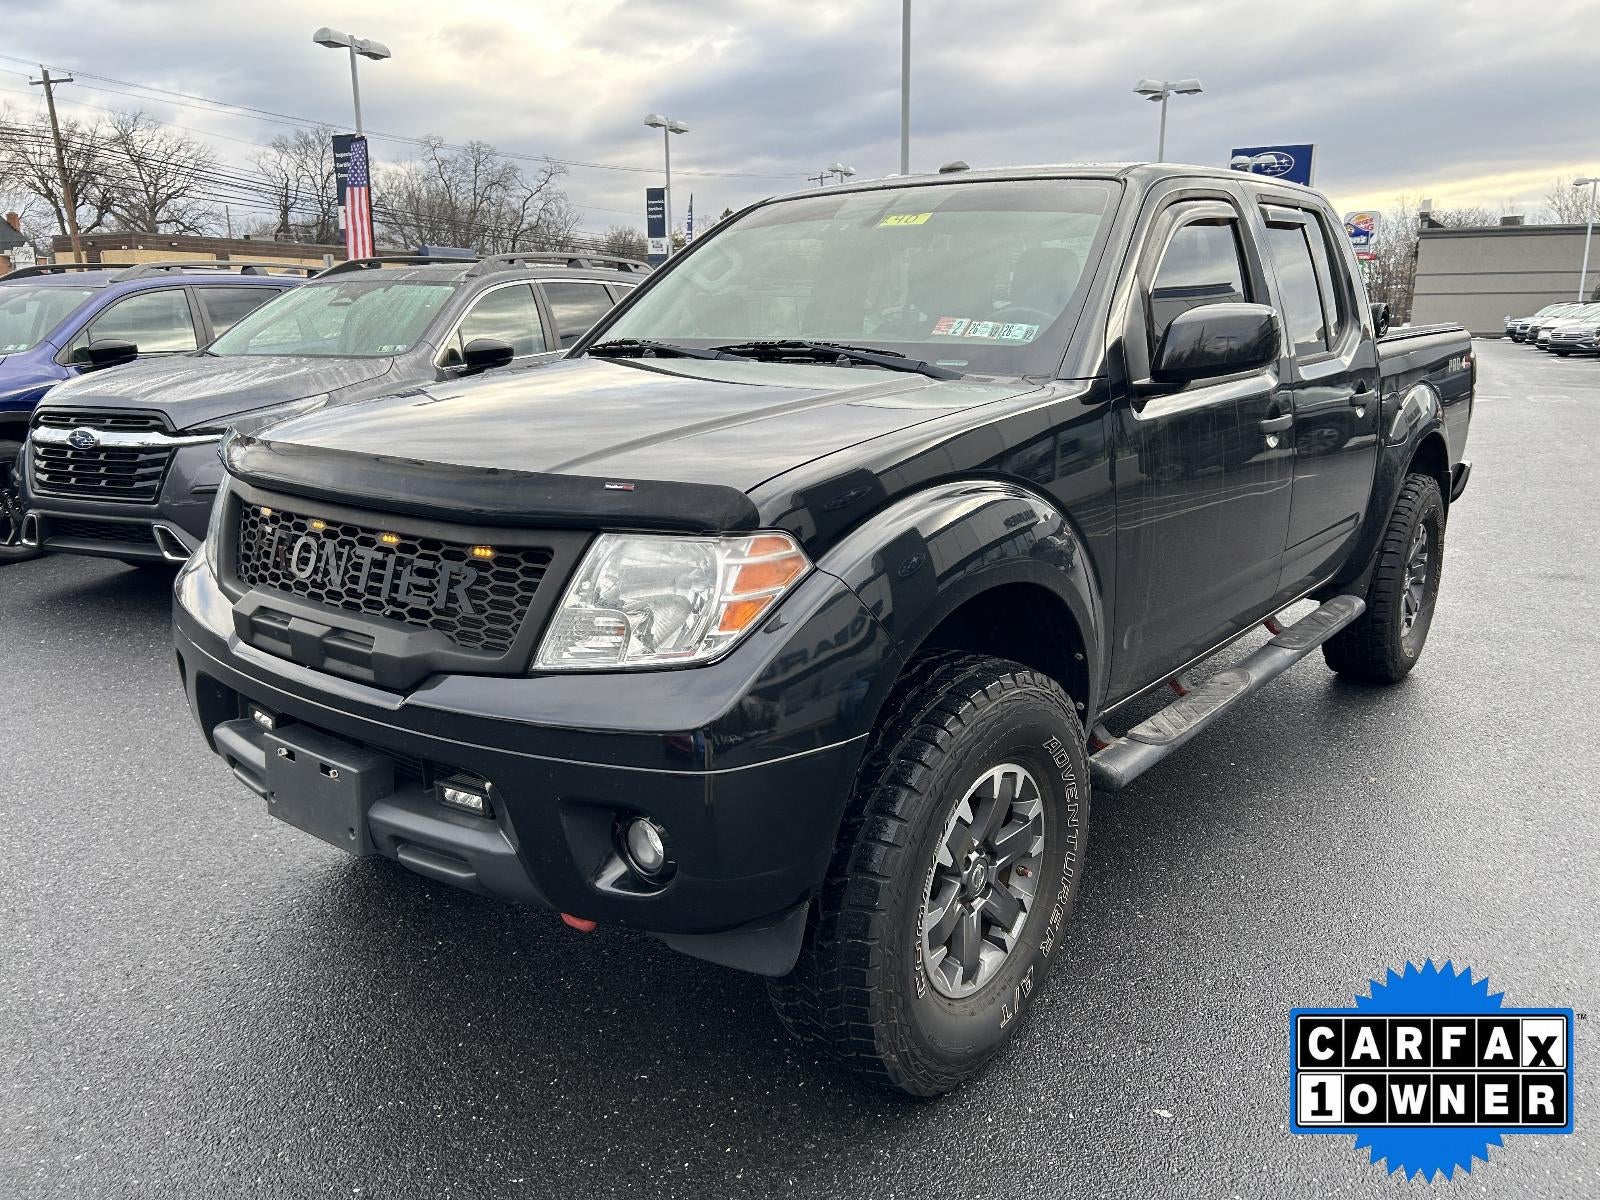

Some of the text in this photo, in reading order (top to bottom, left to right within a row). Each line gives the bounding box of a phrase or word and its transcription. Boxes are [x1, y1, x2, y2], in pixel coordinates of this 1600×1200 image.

[256, 524, 478, 614] FRONTIER
[1000, 735, 1079, 1029] ADVENTURER A/T
